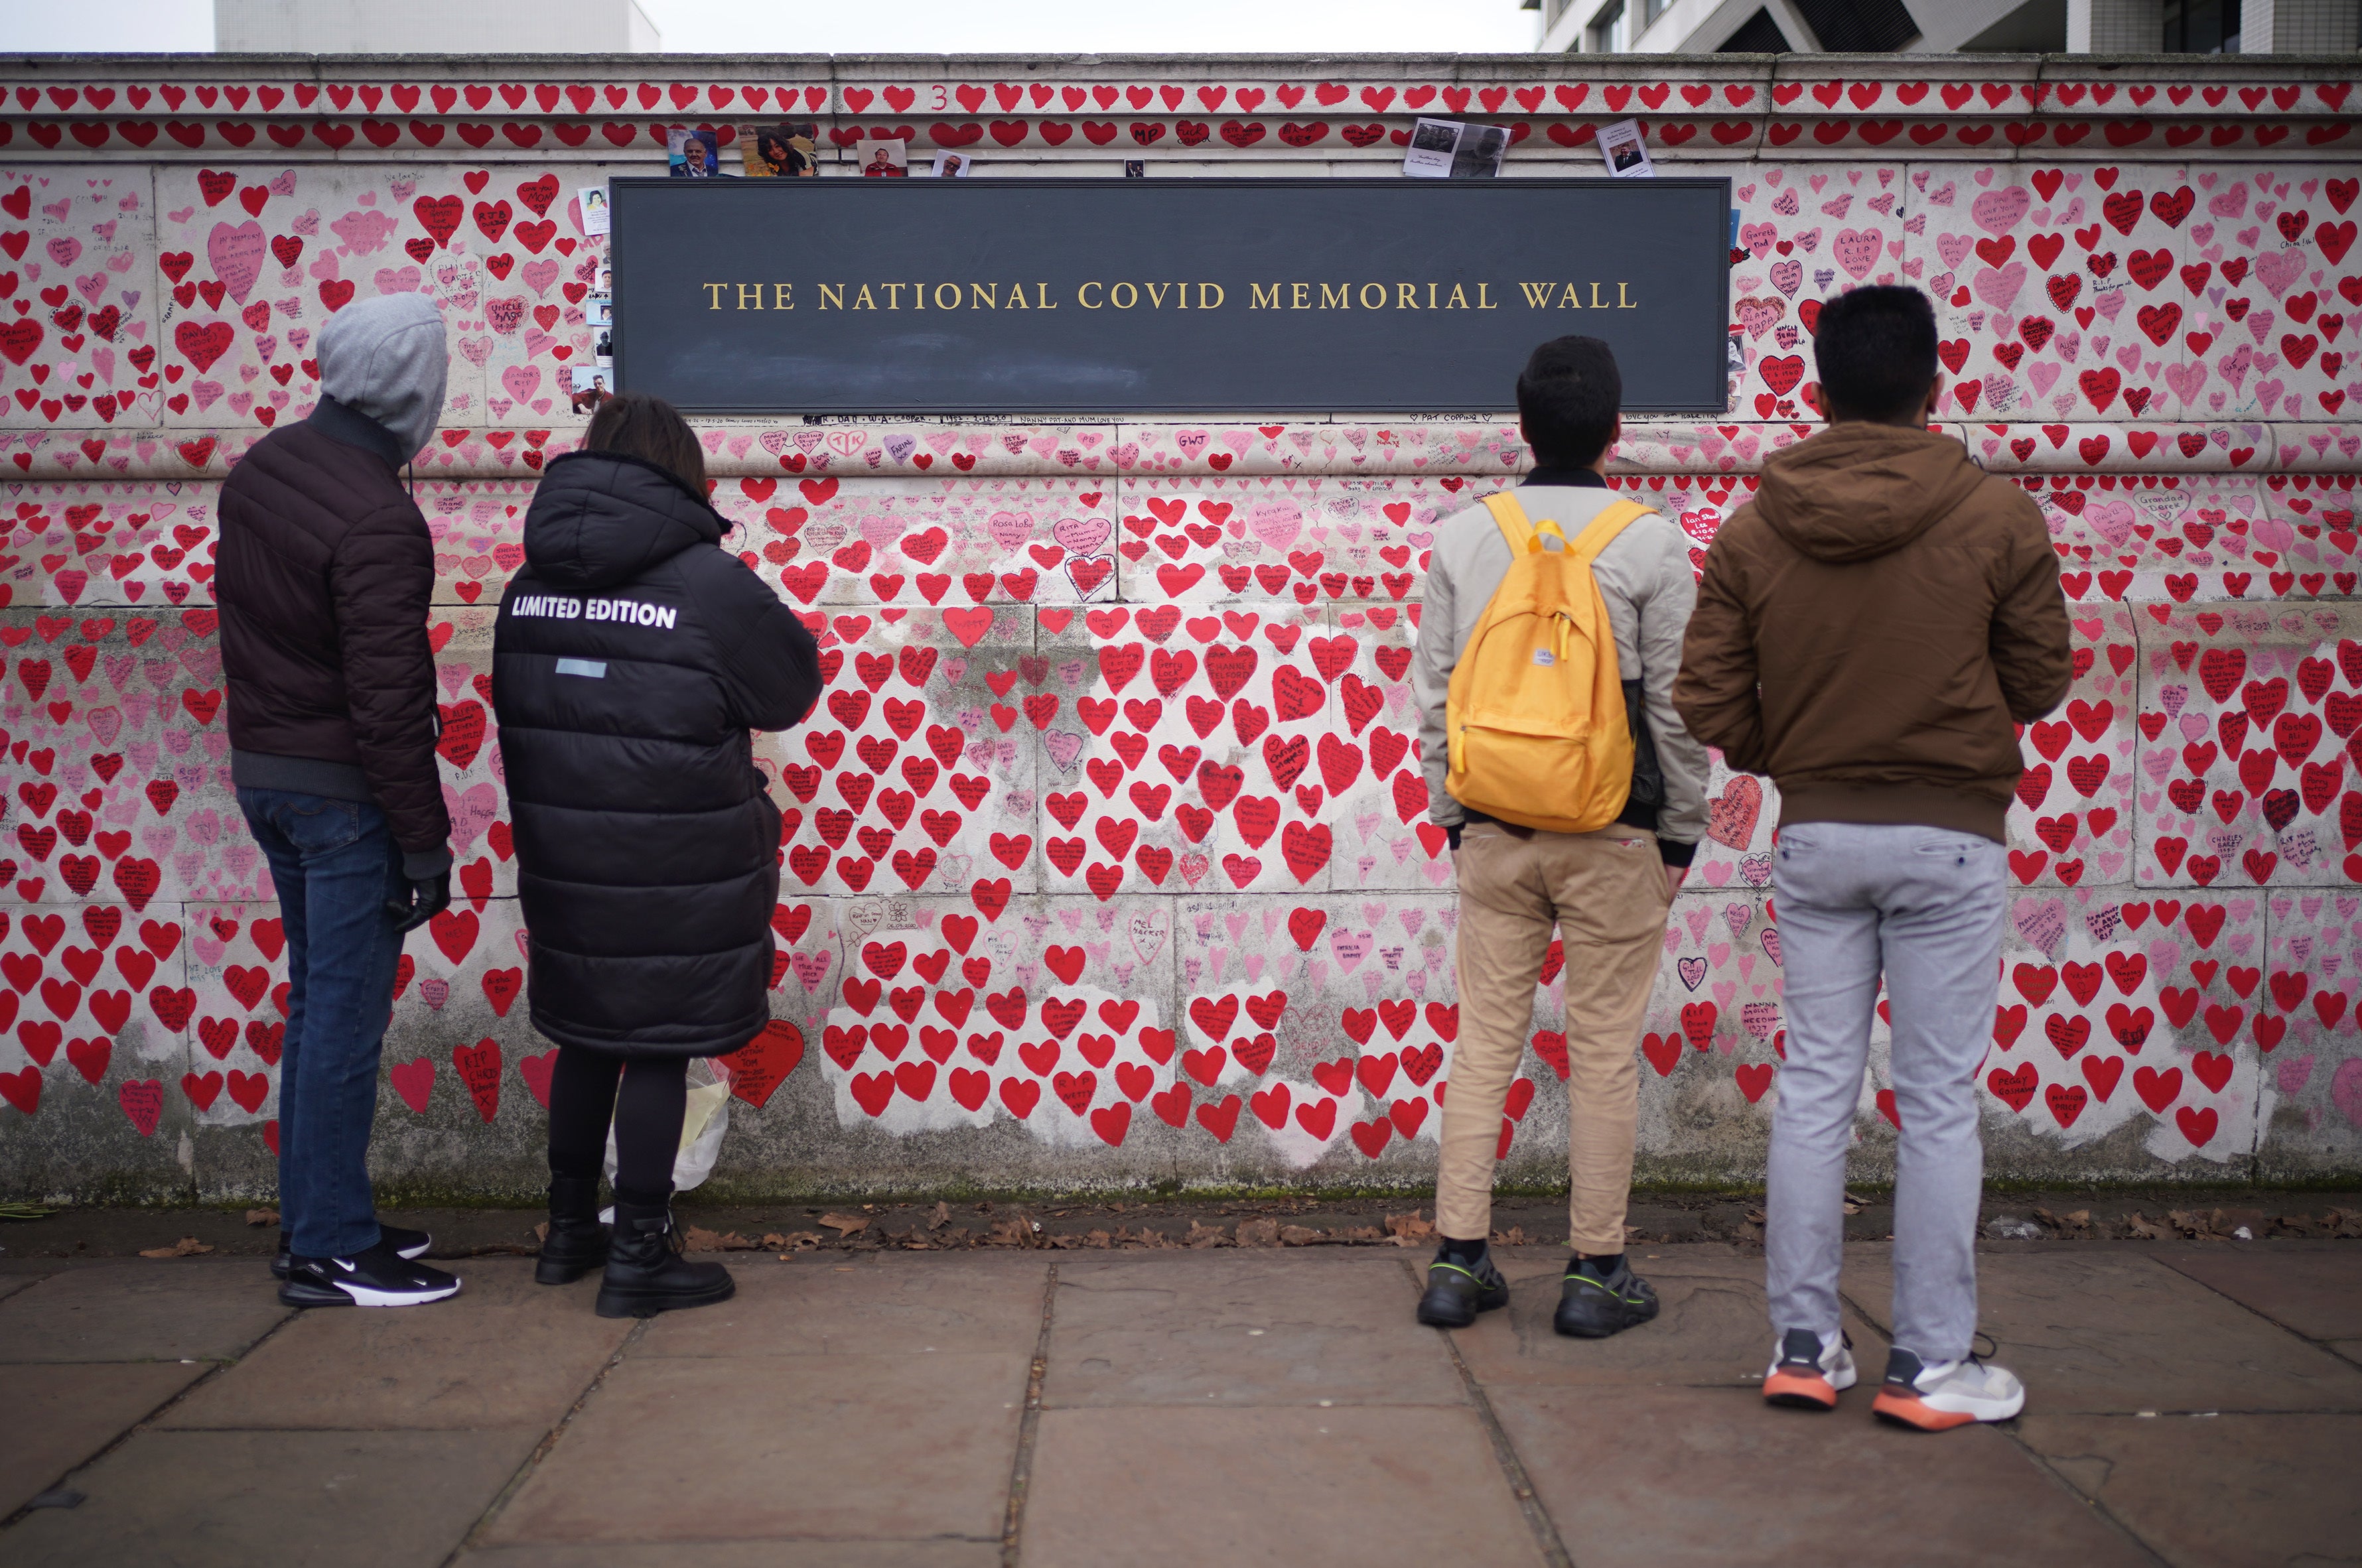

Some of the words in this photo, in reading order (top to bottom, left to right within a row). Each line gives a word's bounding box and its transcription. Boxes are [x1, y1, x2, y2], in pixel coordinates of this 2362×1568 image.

[932, 84, 947, 111] 3
[1133, 129, 1158, 142] MP
[527, 192, 553, 203] MOM
[1746, 229, 1775, 239] Gareth
[1754, 239, 1769, 249] Dad
[1840, 235, 1878, 245] LAURA
[2280, 240, 2300, 249] China
[491, 257, 510, 270] DW
[1844, 255, 1871, 264] LOVE
[2130, 254, 2149, 265] DAD
[1776, 267, 1789, 276] MISS
[2134, 266, 2153, 277] MISS
[2154, 262, 2170, 272] YOU
[1781, 273, 1797, 281] MUM
[84, 279, 99, 292] KIT
[703, 282, 794, 310] THE
[817, 282, 1058, 310] NATIONAL
[1078, 281, 1224, 310] COVID
[1249, 282, 1497, 310] MEMORIAL
[1519, 281, 1637, 310] WALL
[491, 302, 522, 312] UNCLE
[1743, 309, 1768, 324] ALAN
[1748, 316, 1774, 332] PAPA
[1776, 324, 1798, 332] UNCLE
[1776, 332, 1797, 340] JOHN
[1444, 413, 1477, 422] COPPING
[1178, 435, 1206, 447] GWJ
[891, 439, 914, 456] FARIAL
[2140, 494, 2184, 503] Grandad
[1328, 503, 1355, 514] Pilcher
[992, 519, 1013, 529] Rosa
[512, 596, 581, 620] LIMITED
[585, 598, 677, 629] EDITION
[1156, 659, 1182, 672] Gerry
[1216, 681, 1237, 689] RIP
[2251, 701, 2278, 710] Forever
[970, 745, 986, 755] JOE
[27, 790, 48, 807] A2
[2211, 834, 2243, 844] CHARLES
[1134, 919, 1153, 930] MEL
[1743, 1015, 1783, 1025] NEEDHAM
[1748, 1024, 1767, 1033] 1937
[465, 1051, 488, 1069] RIP
[469, 1067, 498, 1083] CHRIS
[1998, 1076, 2028, 1086] PEGGY
[1063, 1090, 1093, 1101] NETTY
[1998, 1085, 2037, 1096] GOSHAWK
